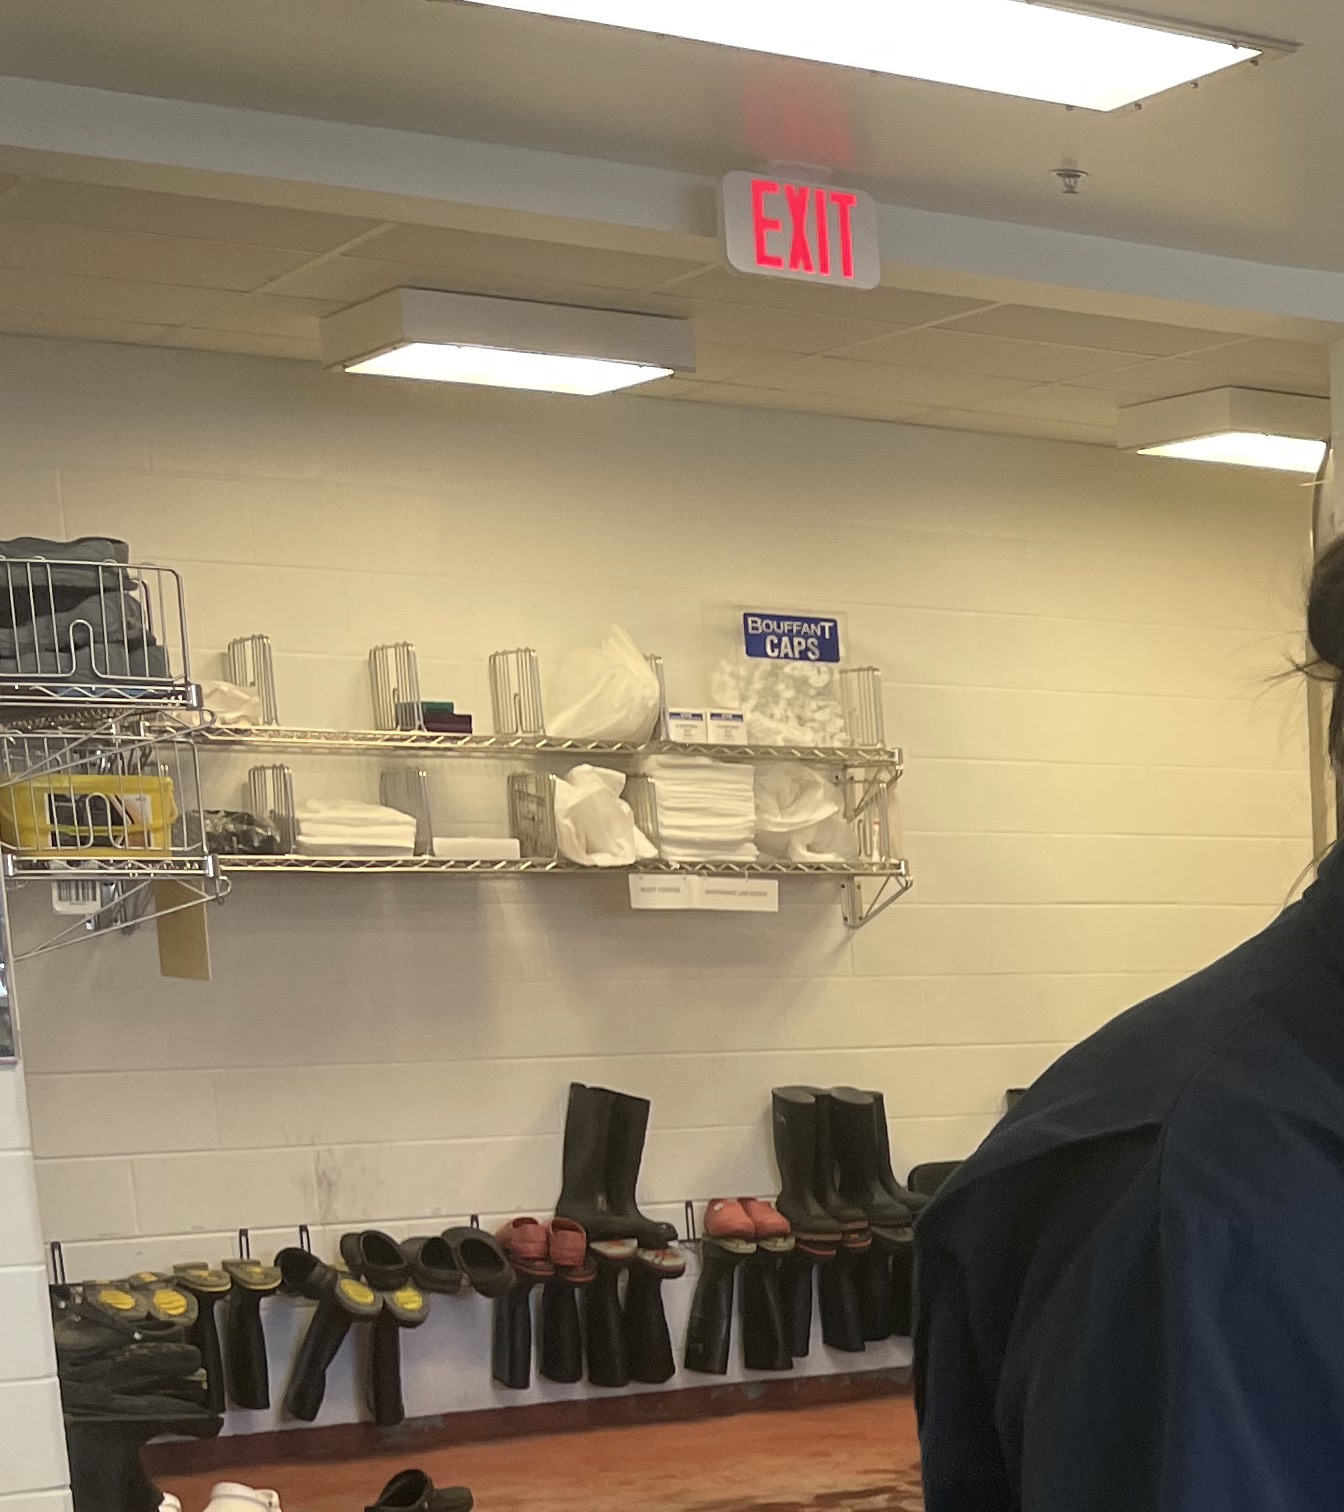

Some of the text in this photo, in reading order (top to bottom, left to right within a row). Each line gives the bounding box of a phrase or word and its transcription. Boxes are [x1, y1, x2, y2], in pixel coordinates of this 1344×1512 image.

[751, 178, 857, 280] EXIT
[748, 616, 834, 639] BOUFFANT
[765, 635, 820, 660] CAPS
